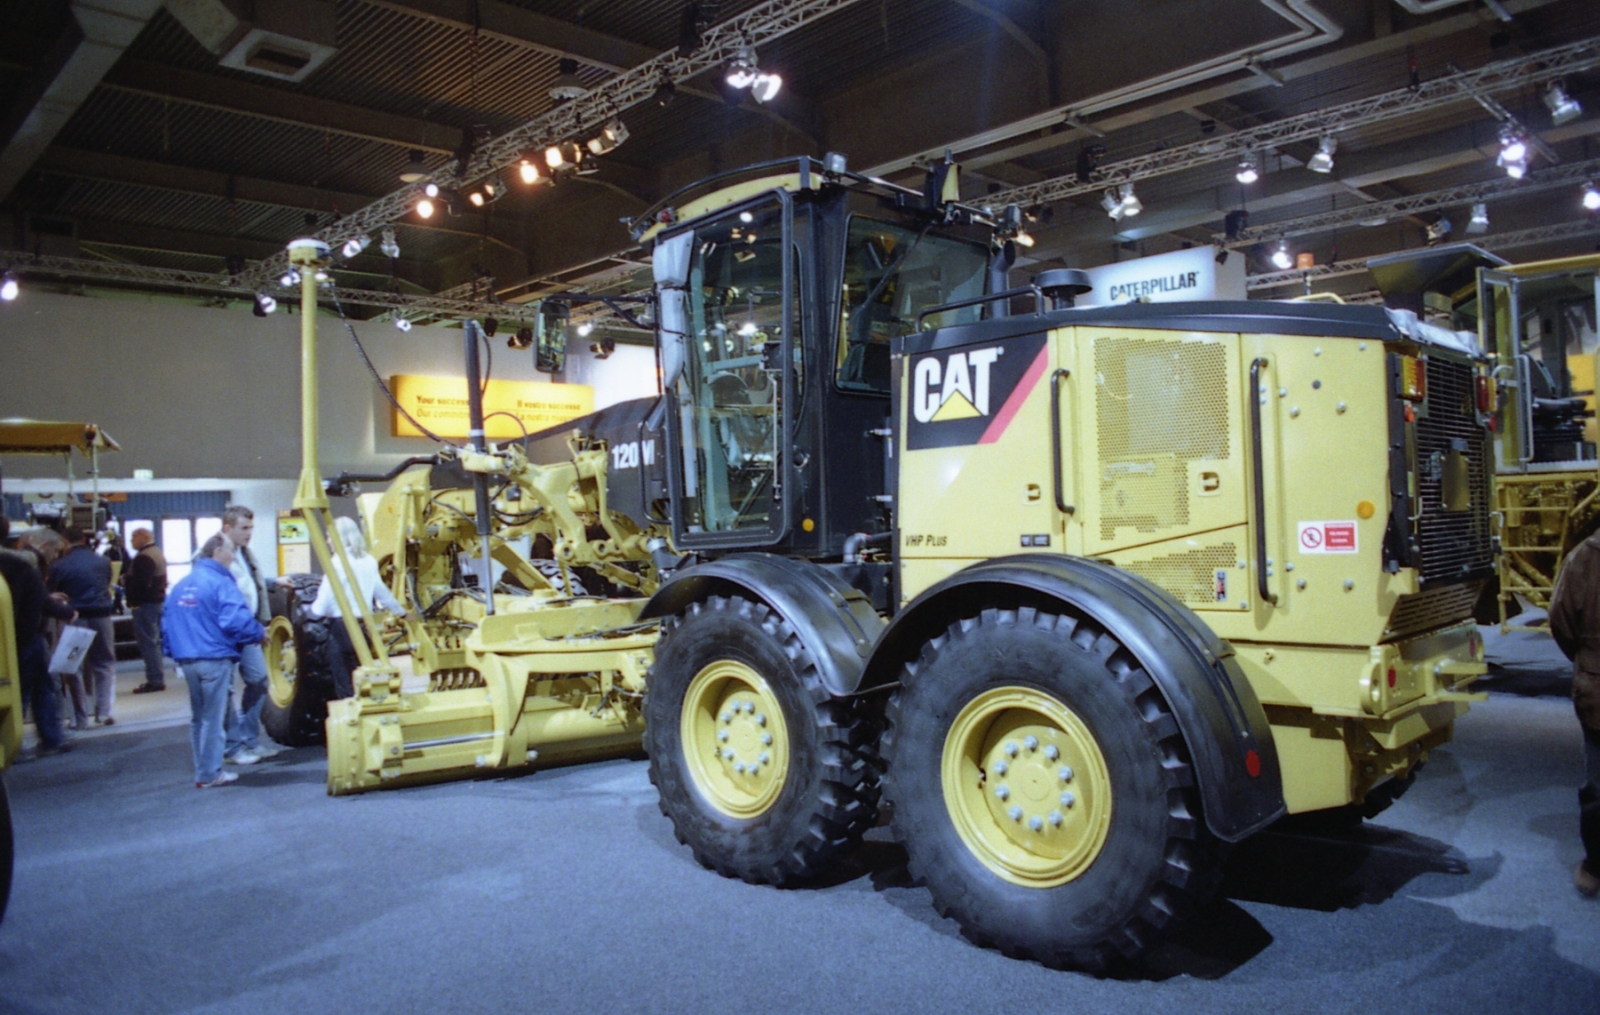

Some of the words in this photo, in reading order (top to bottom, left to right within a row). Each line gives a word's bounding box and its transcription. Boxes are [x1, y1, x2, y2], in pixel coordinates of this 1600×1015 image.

[1110, 272, 1198, 301] CATERPILLAR
[914, 347, 1000, 423] CAT
[416, 395, 434, 404] Your
[416, 408, 431, 418] Our
[905, 534, 923, 547] VHP
